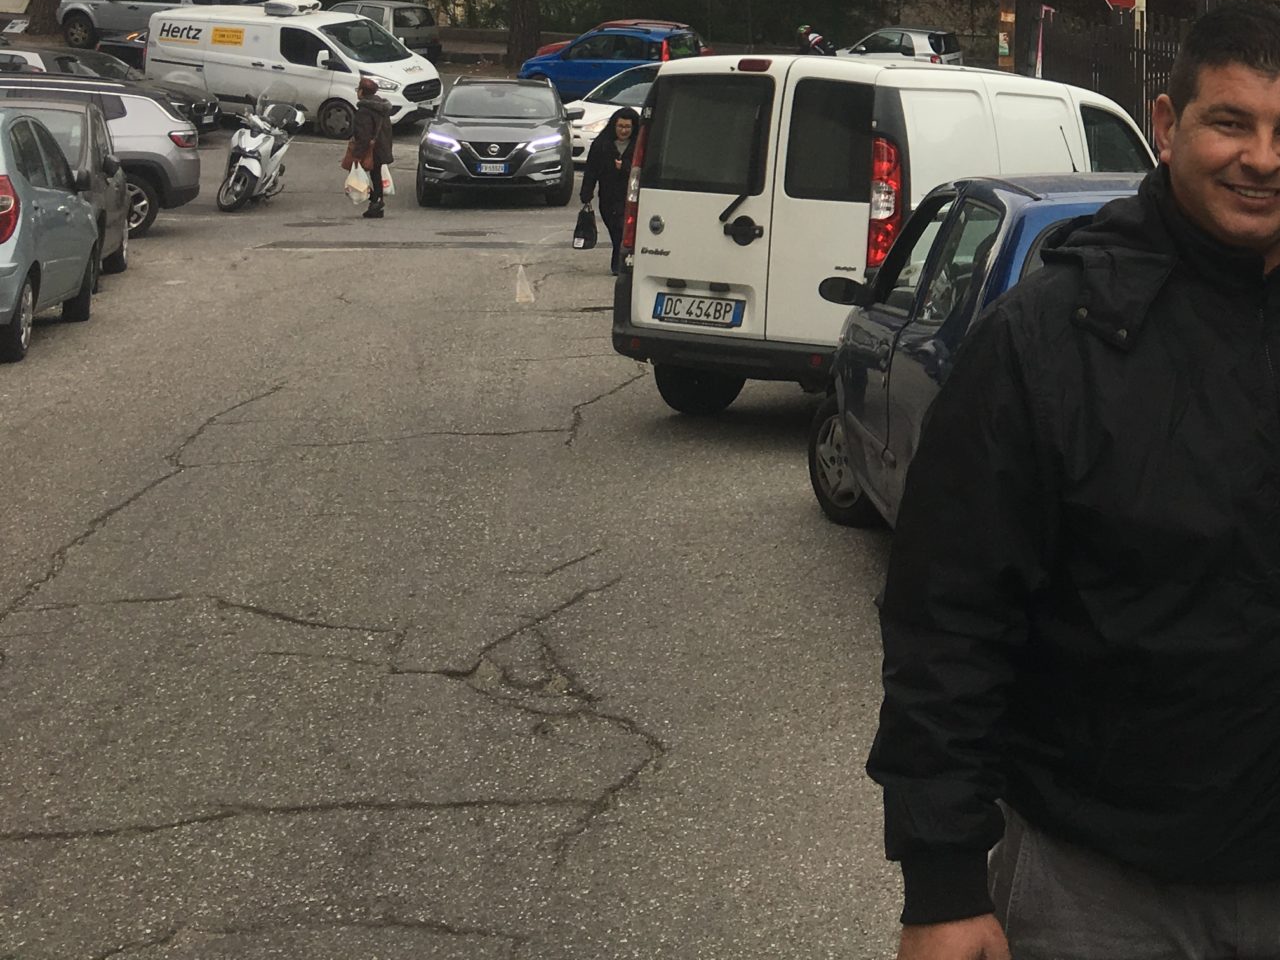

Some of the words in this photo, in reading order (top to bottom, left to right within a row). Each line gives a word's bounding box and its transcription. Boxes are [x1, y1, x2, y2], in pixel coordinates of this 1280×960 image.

[159, 22, 202, 40] Hertz
[663, 297, 683, 316] DC
[685, 299, 733, 321] 454BP
